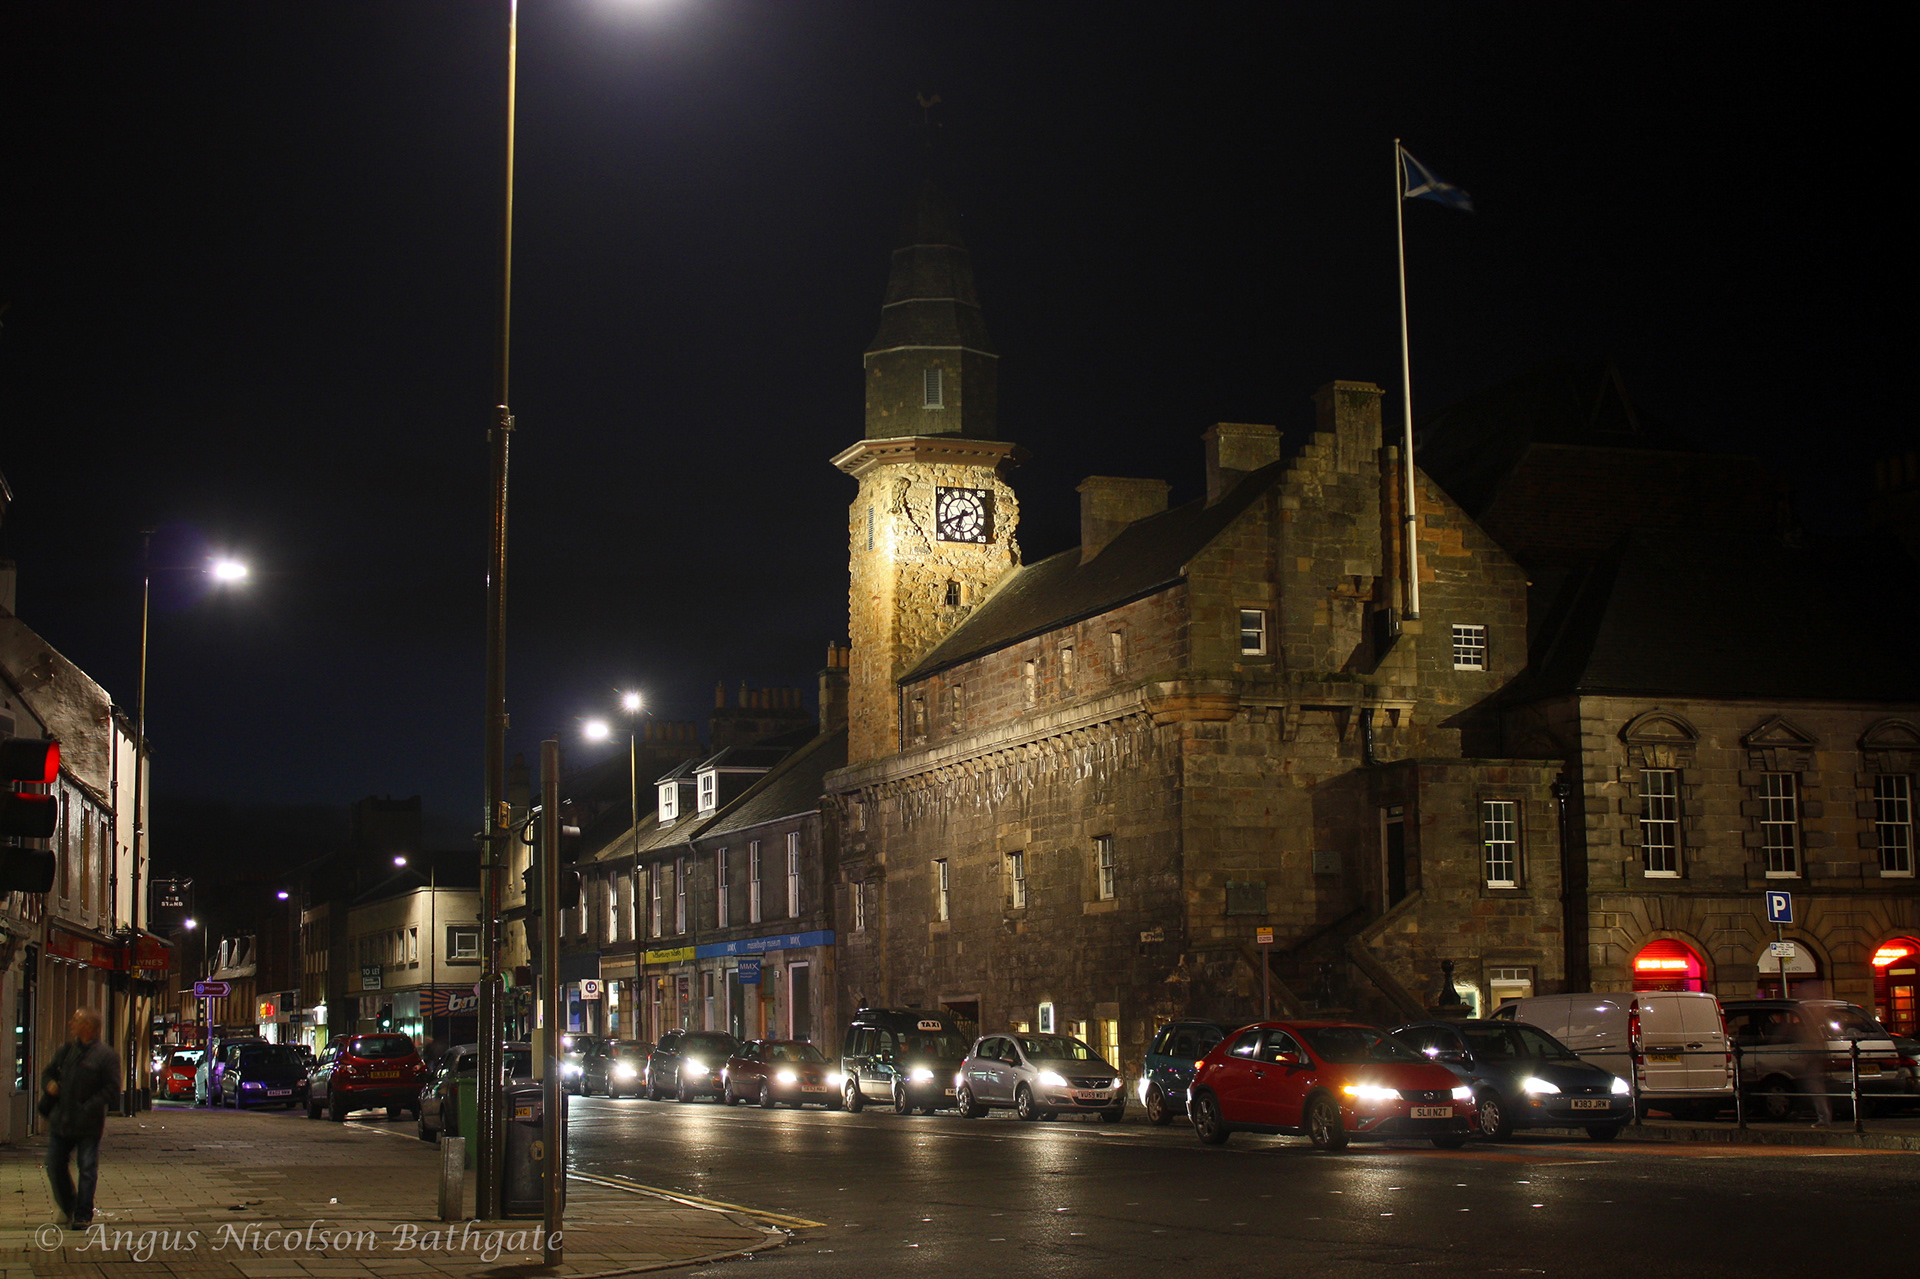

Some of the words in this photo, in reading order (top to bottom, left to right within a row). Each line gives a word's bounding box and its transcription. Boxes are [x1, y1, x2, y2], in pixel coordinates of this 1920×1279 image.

[937, 487, 945, 495] 14
[1772, 895, 1786, 918] P
[740, 962, 759, 970] MMX
[372, 967, 380, 975] LET
[1433, 1108, 1447, 1116] NZT
